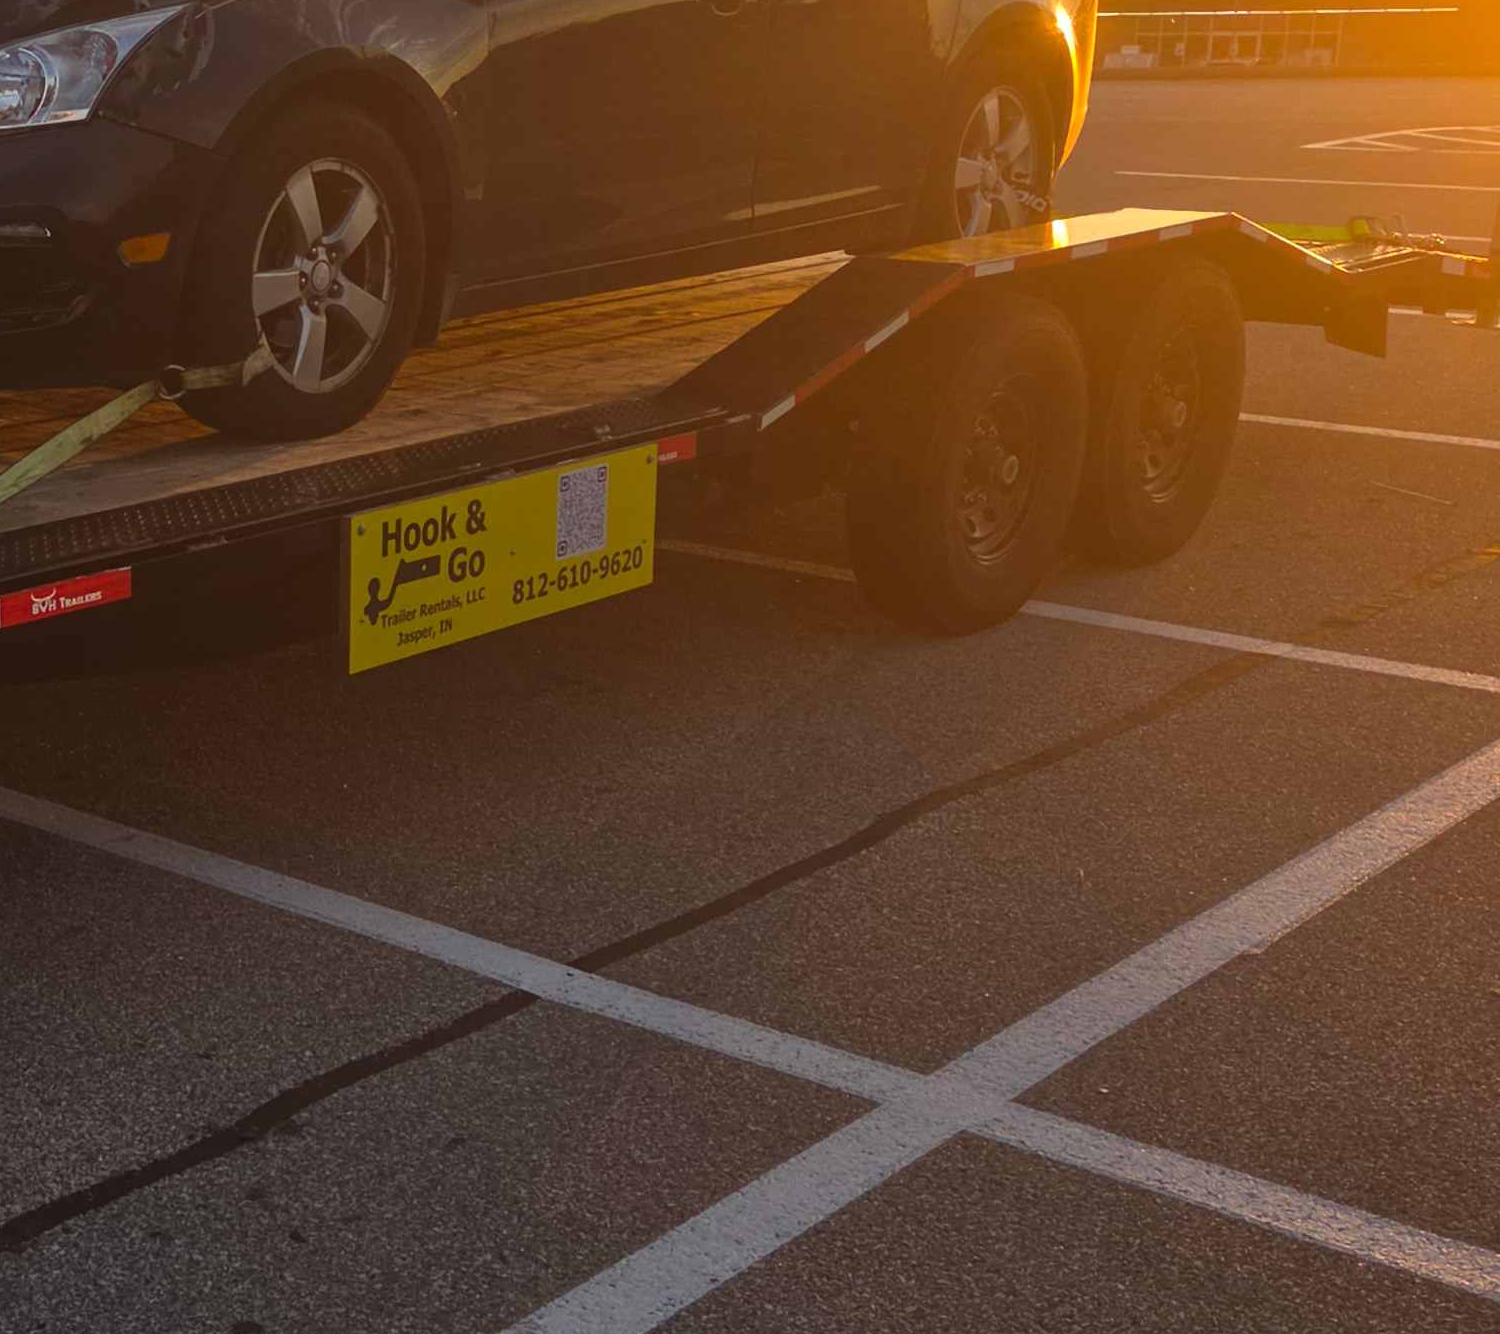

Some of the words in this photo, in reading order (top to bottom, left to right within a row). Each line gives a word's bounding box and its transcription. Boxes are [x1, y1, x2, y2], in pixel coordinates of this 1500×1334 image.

[381, 505, 457, 557] Hook
[465, 498, 488, 535] &
[447, 546, 486, 584] Go
[512, 546, 643, 604] 812-610-9620
[380, 603, 418, 629] Trailer
[419, 593, 464, 619] Rentals,
[466, 585, 487, 605] LLC
[396, 624, 438, 647] Jasper,
[439, 617, 453, 633] IN
